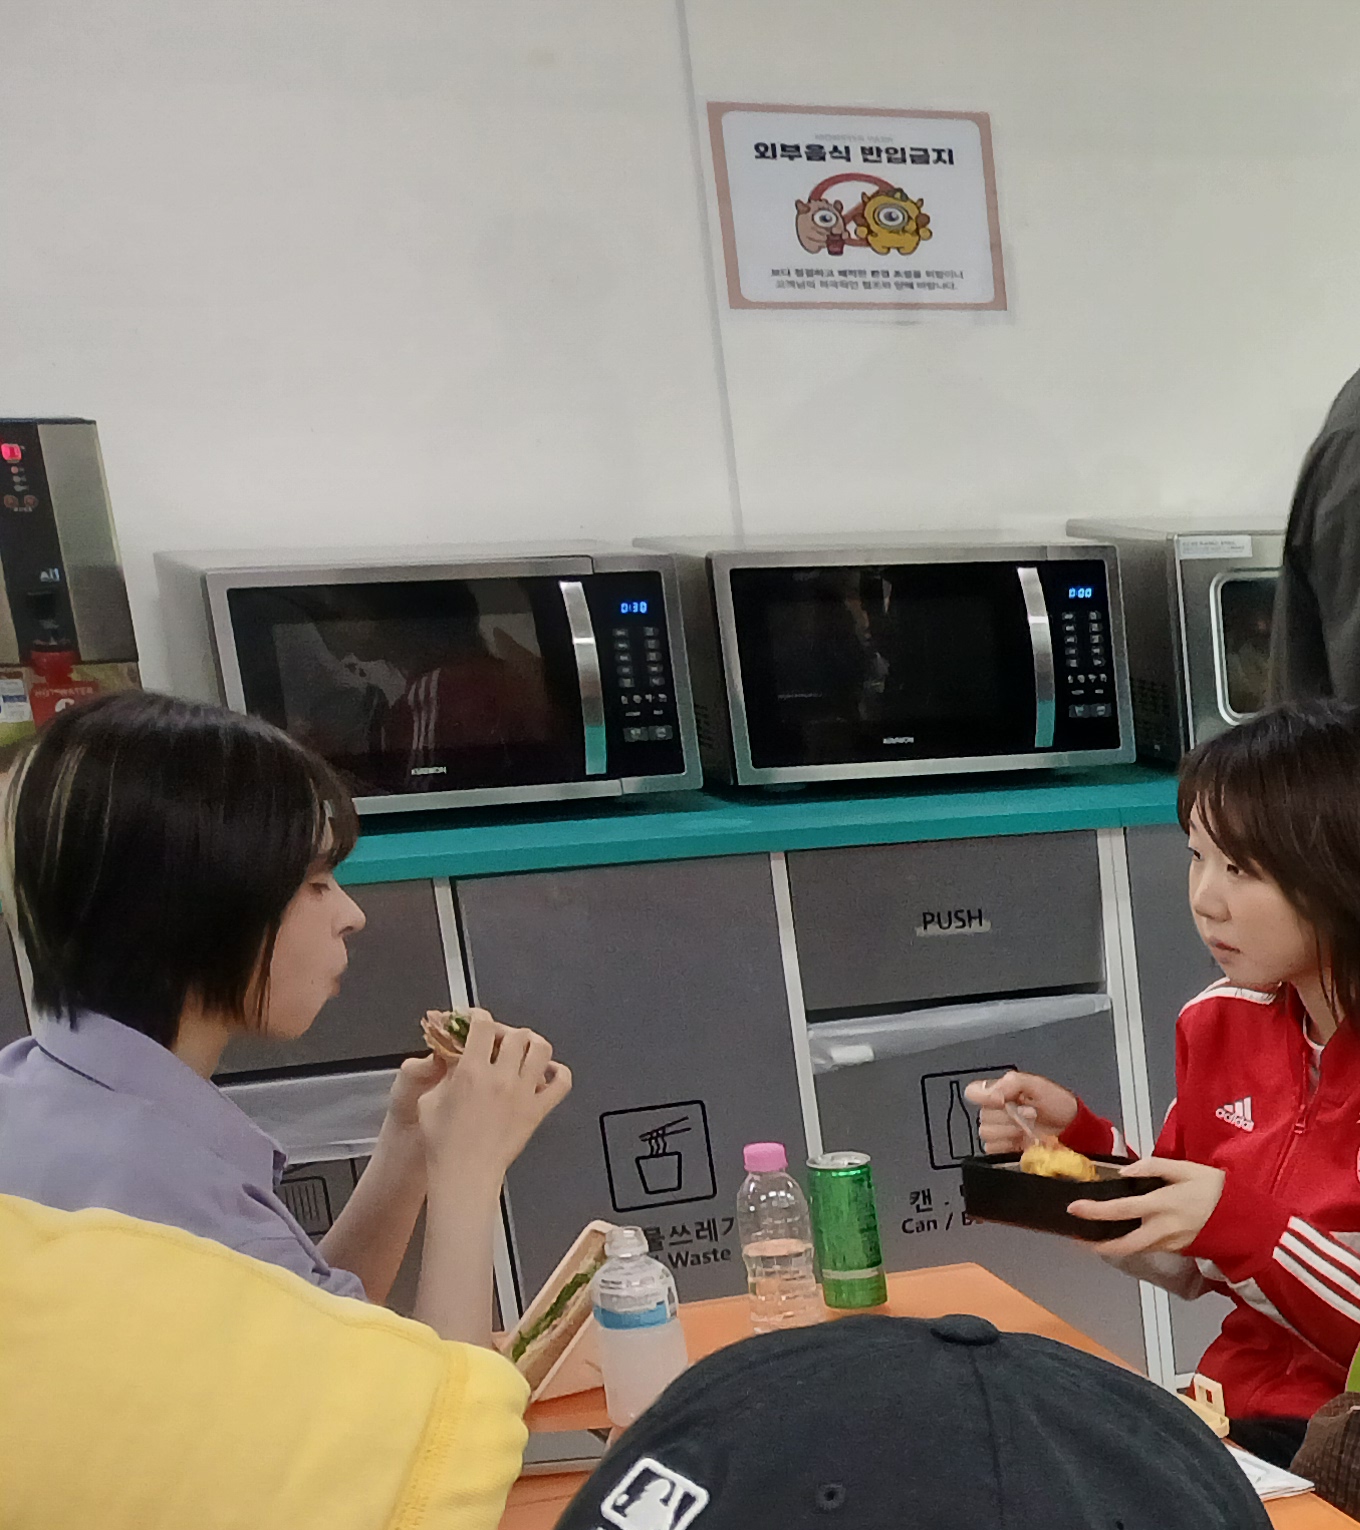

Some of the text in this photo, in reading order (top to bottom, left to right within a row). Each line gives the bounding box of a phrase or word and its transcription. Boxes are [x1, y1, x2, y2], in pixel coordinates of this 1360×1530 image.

[754, 142, 954, 165] 외부음식 반입금지
[922, 908, 984, 931] PUSH
[910, 1188, 933, 1213] 캔
[902, 1217, 938, 1235] Can
[667, 1247, 732, 1269] Waste
